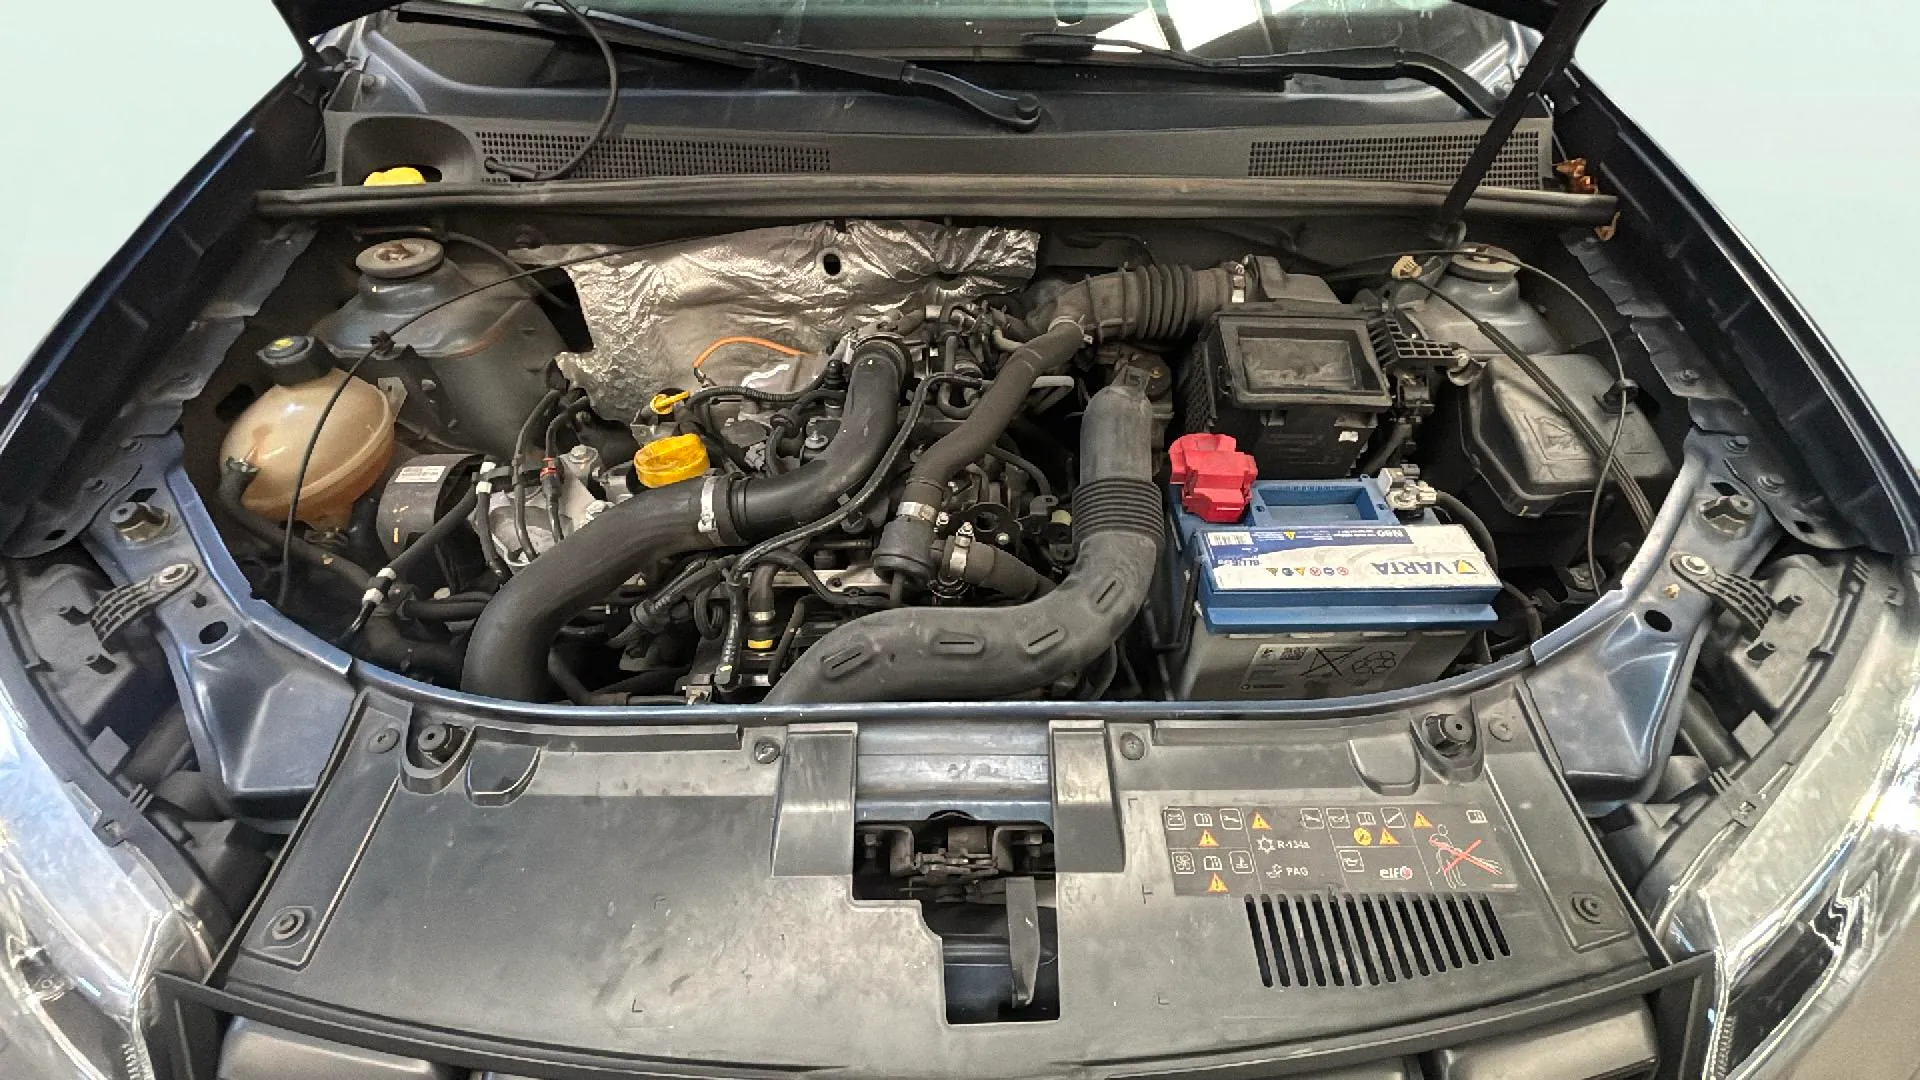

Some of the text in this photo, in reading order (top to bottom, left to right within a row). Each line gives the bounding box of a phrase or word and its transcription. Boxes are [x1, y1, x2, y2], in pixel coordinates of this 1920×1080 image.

[1370, 561, 1453, 575] VARTA
[1277, 839, 1311, 849] R-134a
[1285, 866, 1309, 877] PAG
[1379, 867, 1400, 879] elf
